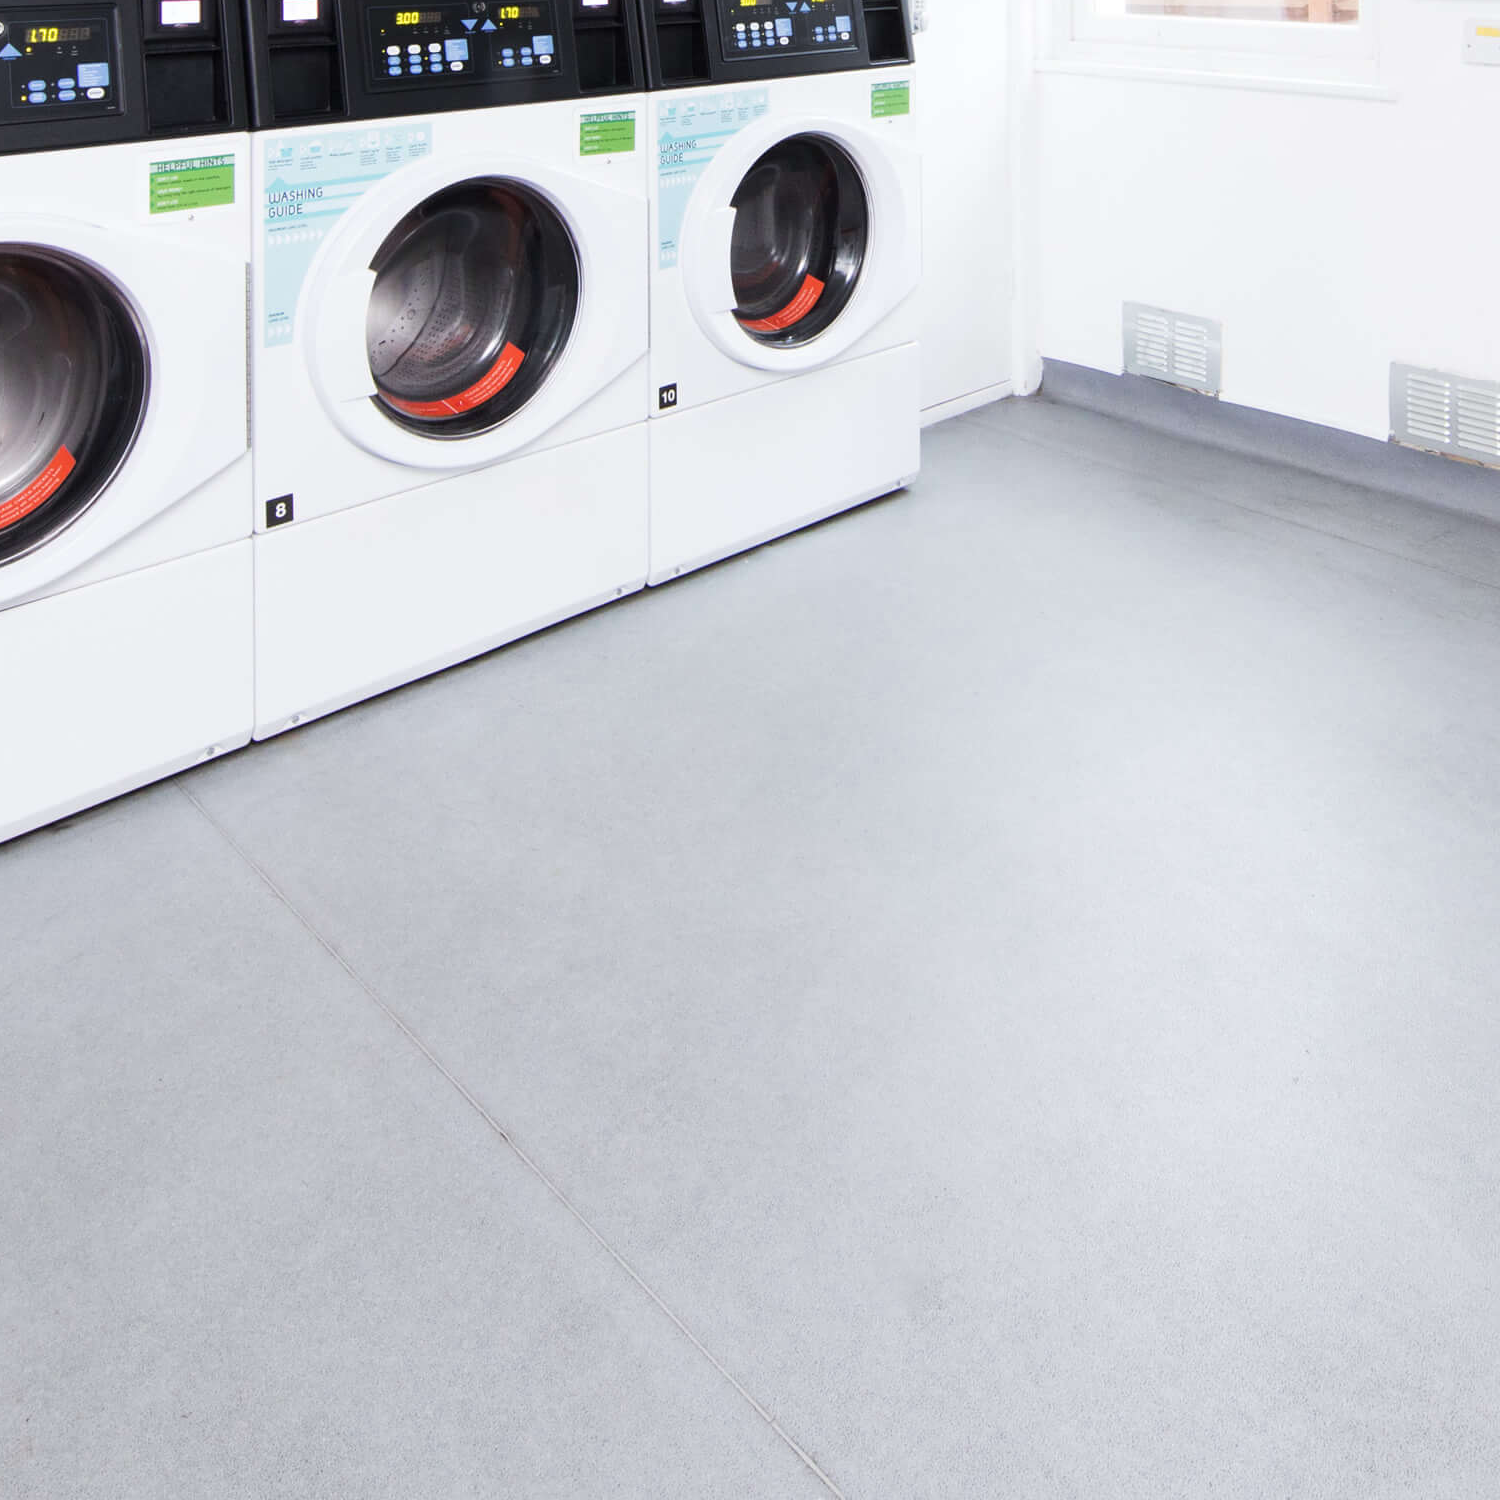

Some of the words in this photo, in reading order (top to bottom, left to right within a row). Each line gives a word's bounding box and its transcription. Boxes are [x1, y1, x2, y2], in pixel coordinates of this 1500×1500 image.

[396, 12, 419, 25] 3.00
[30, 28, 59, 42] 1.70
[660, 139, 697, 154] WASHING
[157, 161, 196, 172] HELPFUL
[200, 157, 225, 166] HINTS
[660, 153, 684, 165] GUIDE
[268, 187, 323, 204] WASHING
[268, 204, 303, 218] GUIDE
[662, 389, 675, 403] 10
[276, 502, 286, 518] 8
